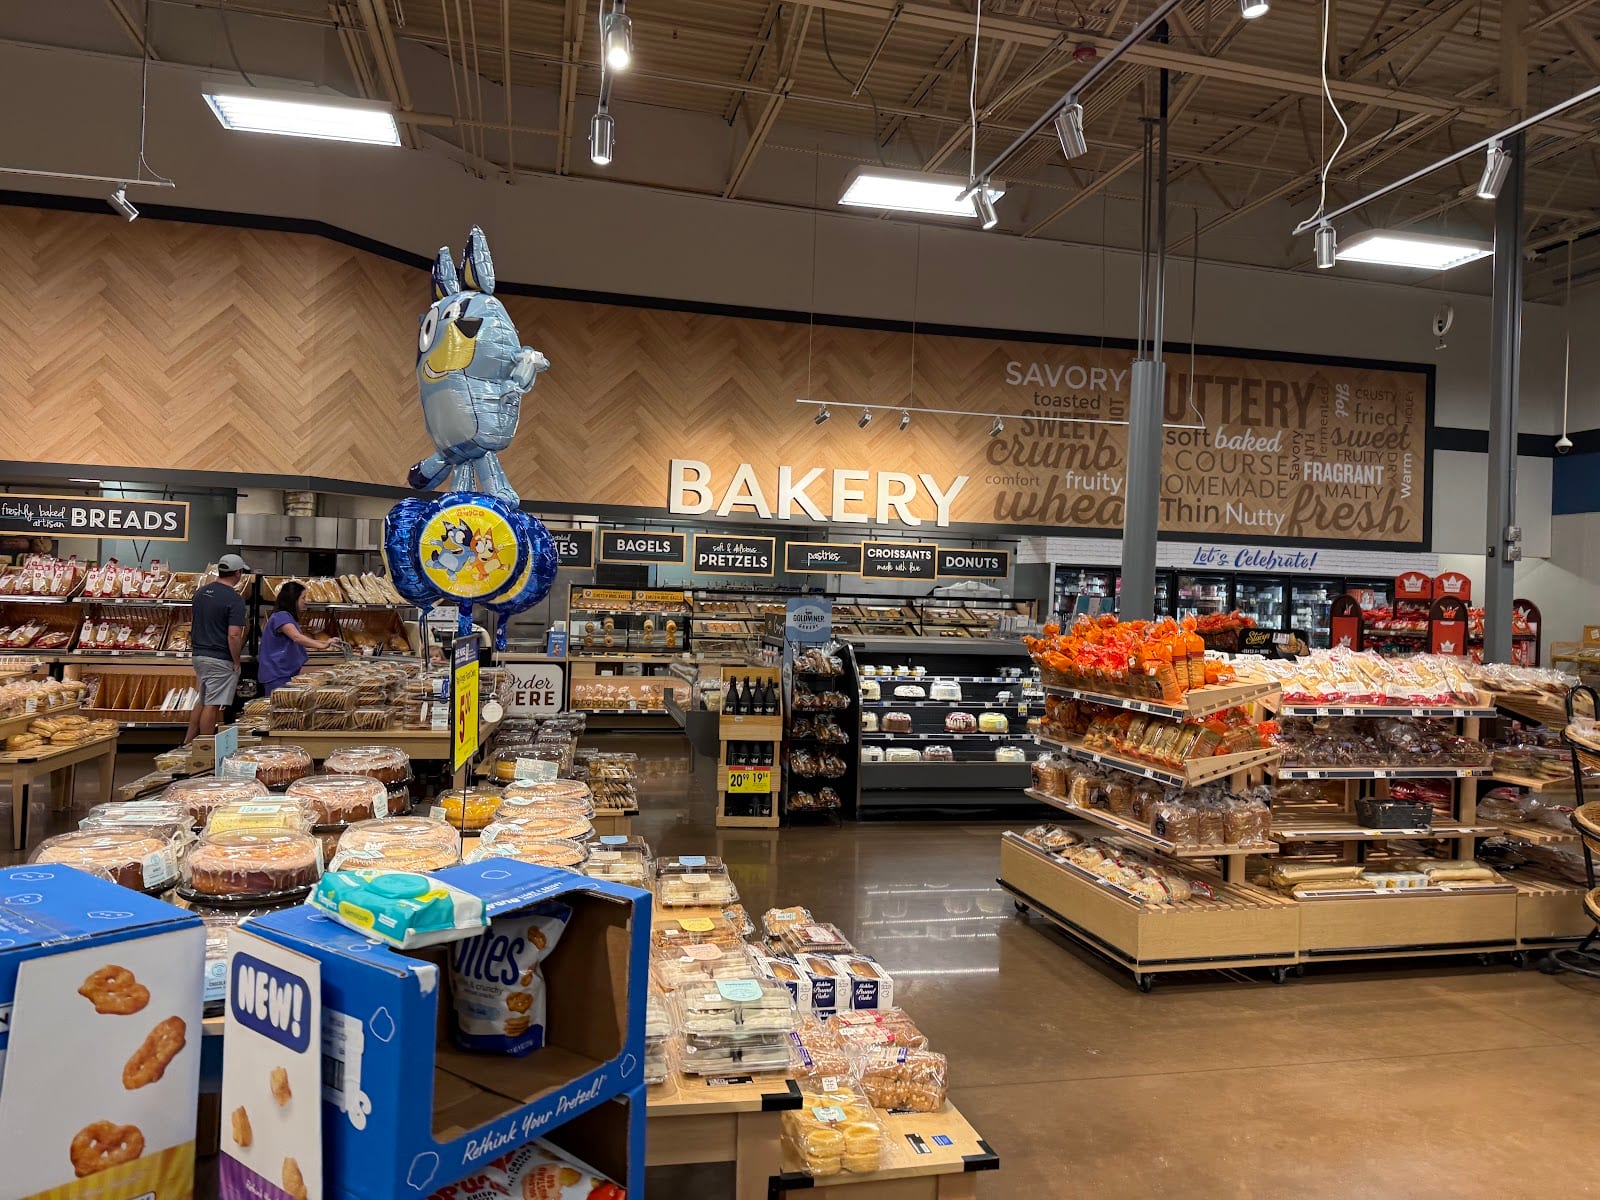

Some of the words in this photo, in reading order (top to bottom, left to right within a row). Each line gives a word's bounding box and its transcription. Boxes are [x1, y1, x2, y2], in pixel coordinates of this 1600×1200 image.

[1005, 361, 1128, 392] SAVORY
[1034, 391, 1101, 410] toasted
[1164, 373, 1316, 429] UTTERY
[1335, 383, 1350, 418] Hot
[1355, 389, 1398, 401] CRUSTY
[1020, 409, 1100, 441] SWEET
[1355, 403, 1399, 426] fried
[986, 429, 1124, 471] crumb
[1165, 428, 1210, 447] soft
[1214, 426, 1283, 453] baked
[1330, 424, 1412, 451] sweet
[1175, 449, 1289, 476] COURSE
[1289, 430, 1304, 481] Savory
[1337, 449, 1385, 464] FRUITY
[985, 472, 1040, 487] comfort
[1303, 461, 1384, 485] FRAGRANT
[1387, 452, 1399, 486] DRY
[1400, 453, 1413, 499] Warm
[668, 458, 970, 528] BAKERY
[1065, 470, 1123, 496] fruity
[1160, 474, 1288, 499] OMEMADE
[1325, 484, 1384, 500] MALTY
[1, 503, 34, 522] freshly
[38, 504, 66, 519] baked
[993, 475, 1125, 526] whea
[1160, 497, 1219, 523] Thin
[1287, 483, 1410, 537] fresh
[32, 518, 65, 529] artisan
[71, 507, 178, 531] BREADS
[1225, 502, 1286, 535] Nutty
[616, 538, 671, 553] BAGELS
[807, 549, 841, 566] pastries
[867, 548, 932, 560] CROISSANTS
[699, 553, 768, 568] PRETZELS
[876, 563, 894, 572] made
[895, 563, 907, 572] with
[909, 563, 921, 572] love
[945, 556, 999, 569] DONUTS
[1193, 546, 1229, 566] Let's
[1234, 548, 1318, 571] Celebrate!
[514, 691, 556, 706] ERE
[238, 964, 304, 1038] NEW!
[462, 1121, 518, 1166] Rethink
[521, 1111, 553, 1139] Your
